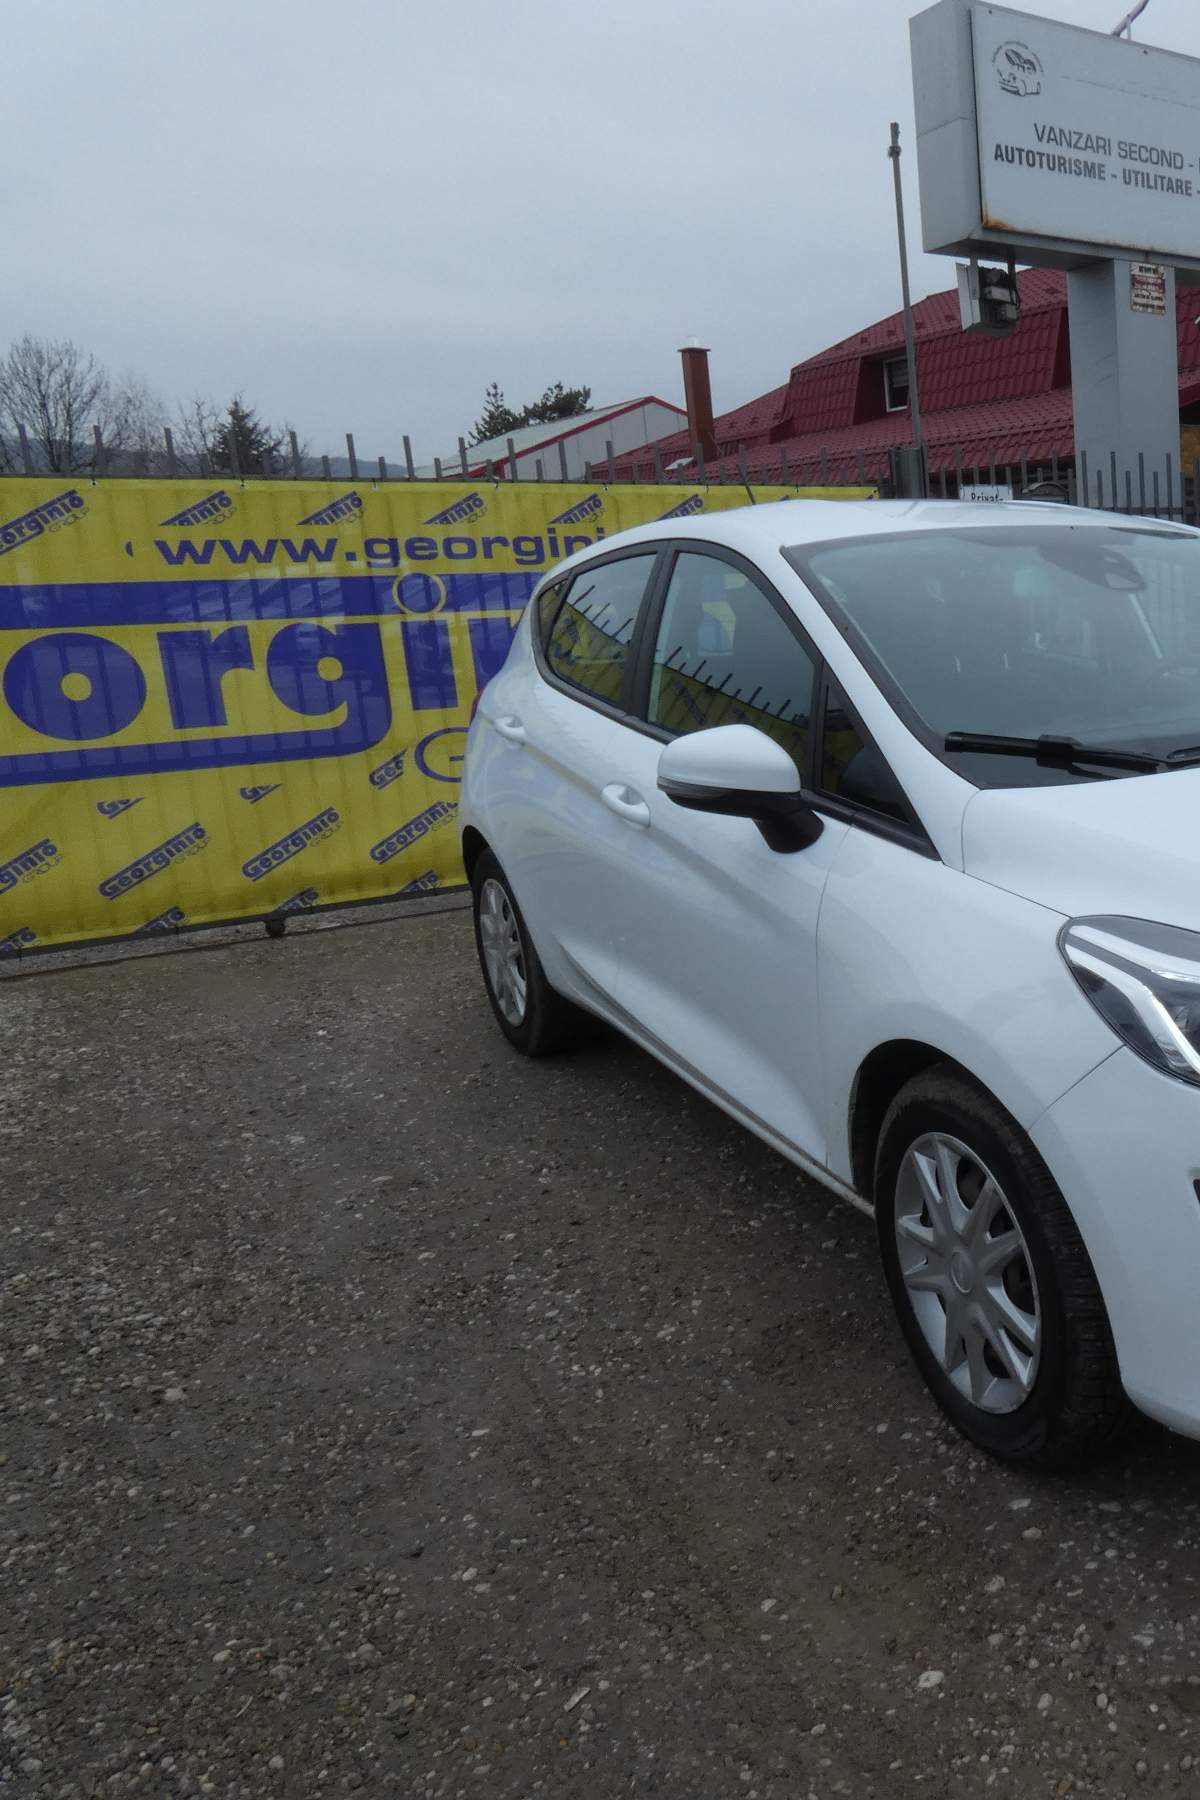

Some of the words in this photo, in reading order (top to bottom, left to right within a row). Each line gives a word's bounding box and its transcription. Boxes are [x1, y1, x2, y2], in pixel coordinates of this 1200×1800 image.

[993, 142, 1107, 182] AUTOTURISME
[1122, 166, 1193, 198] UTILITARE
[1033, 122, 1113, 157] VANZARI
[1117, 138, 1185, 171] SECOND
[0, 489, 85, 550] orginio
[971, 492, 1004, 502] Privat
[99, 822, 206, 899] Georginio
[241, 807, 340, 880] Georginio
